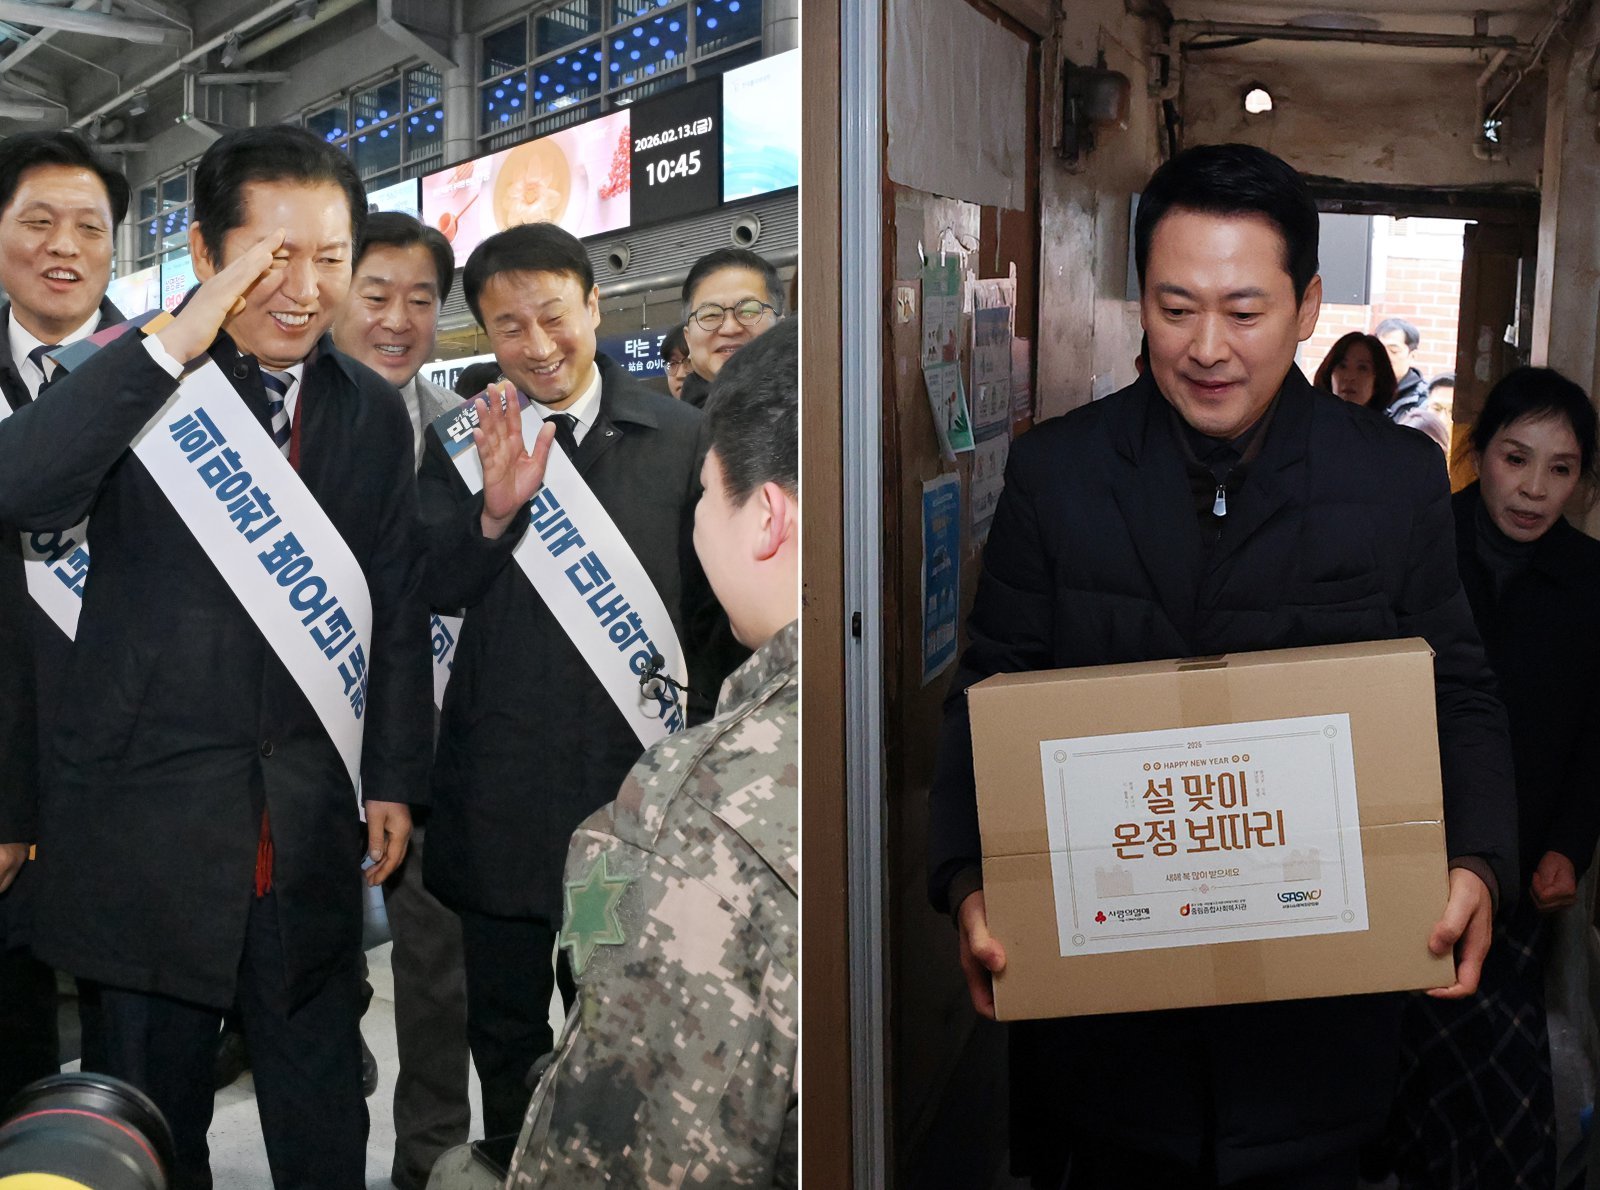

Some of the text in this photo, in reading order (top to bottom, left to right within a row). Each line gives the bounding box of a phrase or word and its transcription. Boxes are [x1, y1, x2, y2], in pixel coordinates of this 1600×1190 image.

[634, 117, 713, 153] 2026.02.13.(금)
[646, 149, 701, 186] 10:45
[624, 338, 650, 359] 타는
[168, 406, 282, 544] 희망찬
[257, 531, 357, 661] 병오년
[530, 487, 587, 558] 민국
[30, 530, 91, 599] 오년
[1163, 757, 1230, 769] HAPPY NEW YEAR
[1112, 809, 1286, 860] 온정 보따리
[1165, 871, 1182, 882] 새해
[1191, 870, 1208, 881] 많이
[1208, 867, 1240, 879] 받으세요
